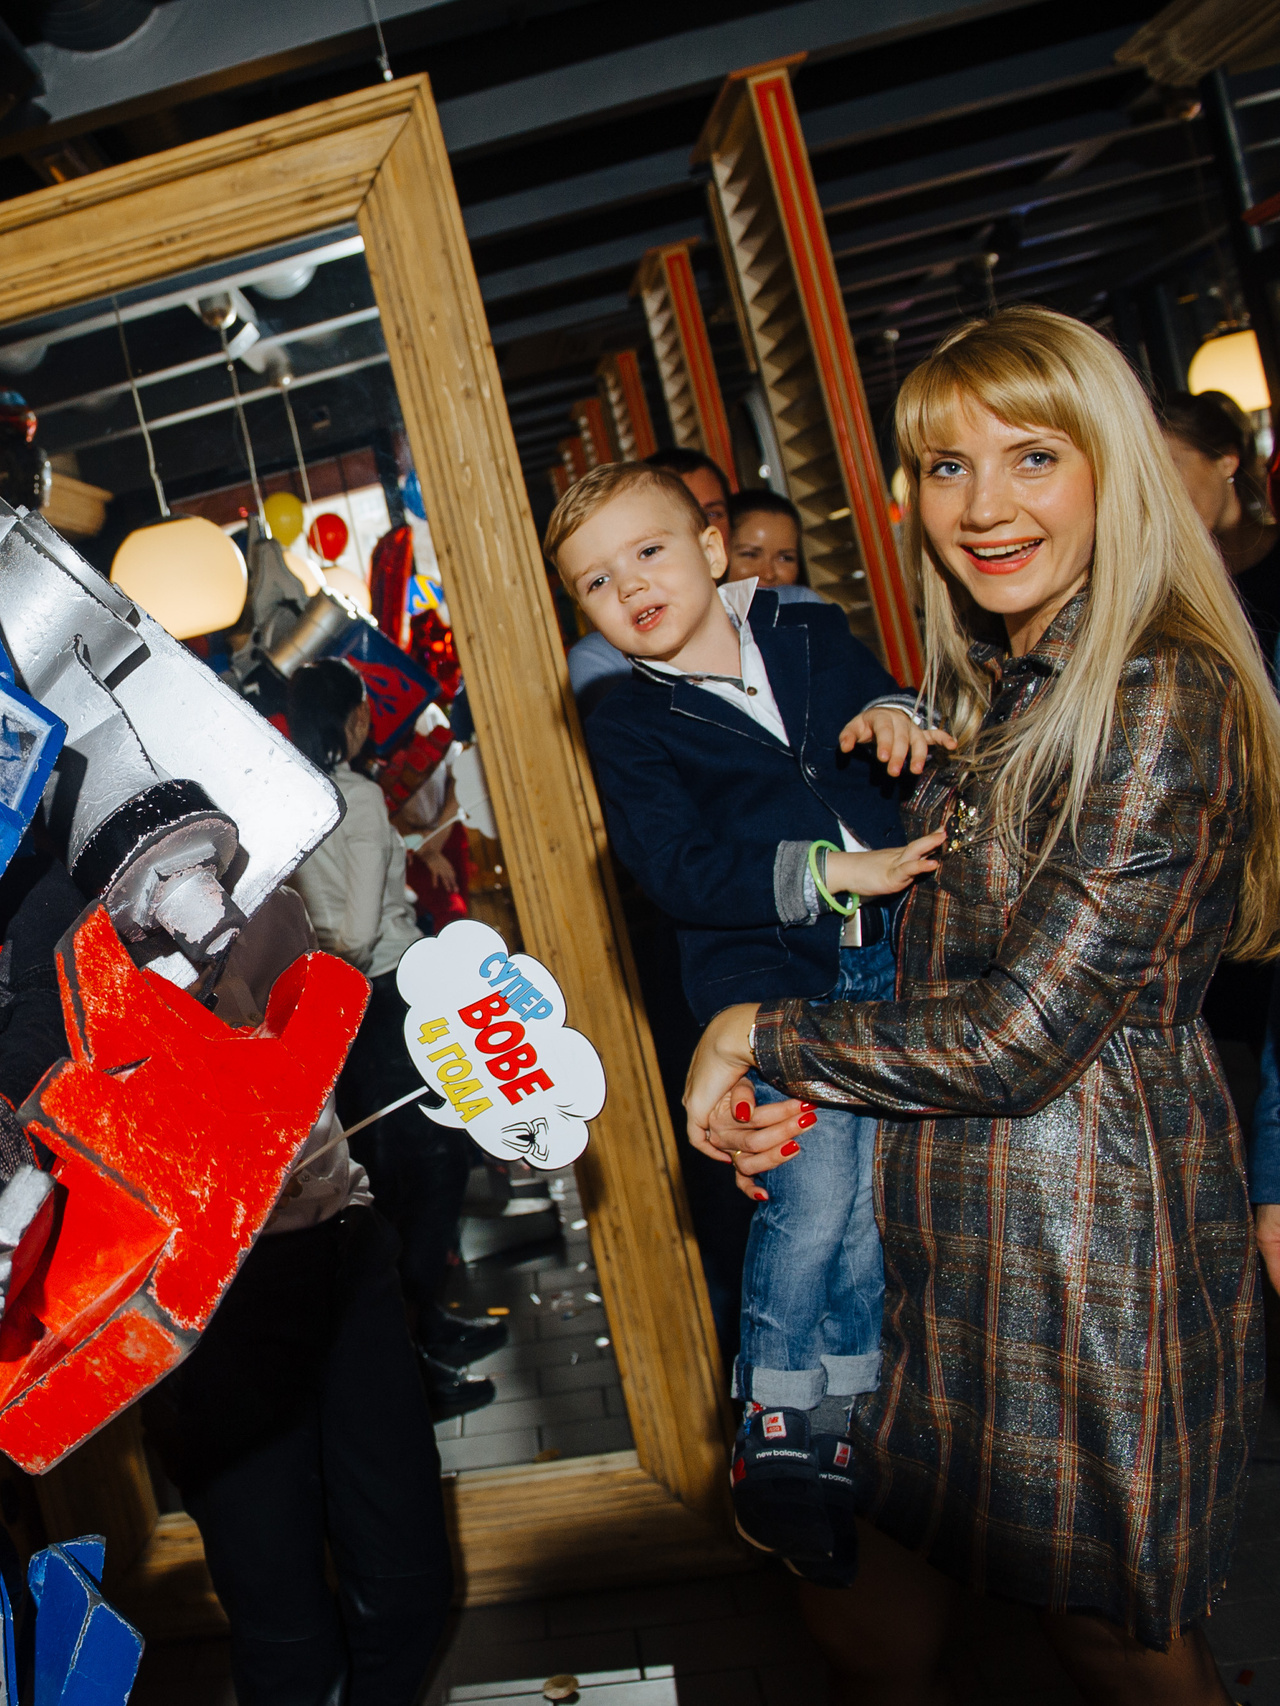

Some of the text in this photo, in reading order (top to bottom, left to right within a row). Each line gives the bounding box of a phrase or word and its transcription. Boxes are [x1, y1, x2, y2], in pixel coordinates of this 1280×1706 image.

[479, 952, 553, 1022] СУПЕР
[417, 1017, 493, 1123] 4 ГОДА
[458, 990, 555, 1105] ВОВЕ
[756, 1449, 808, 1459] new balance
